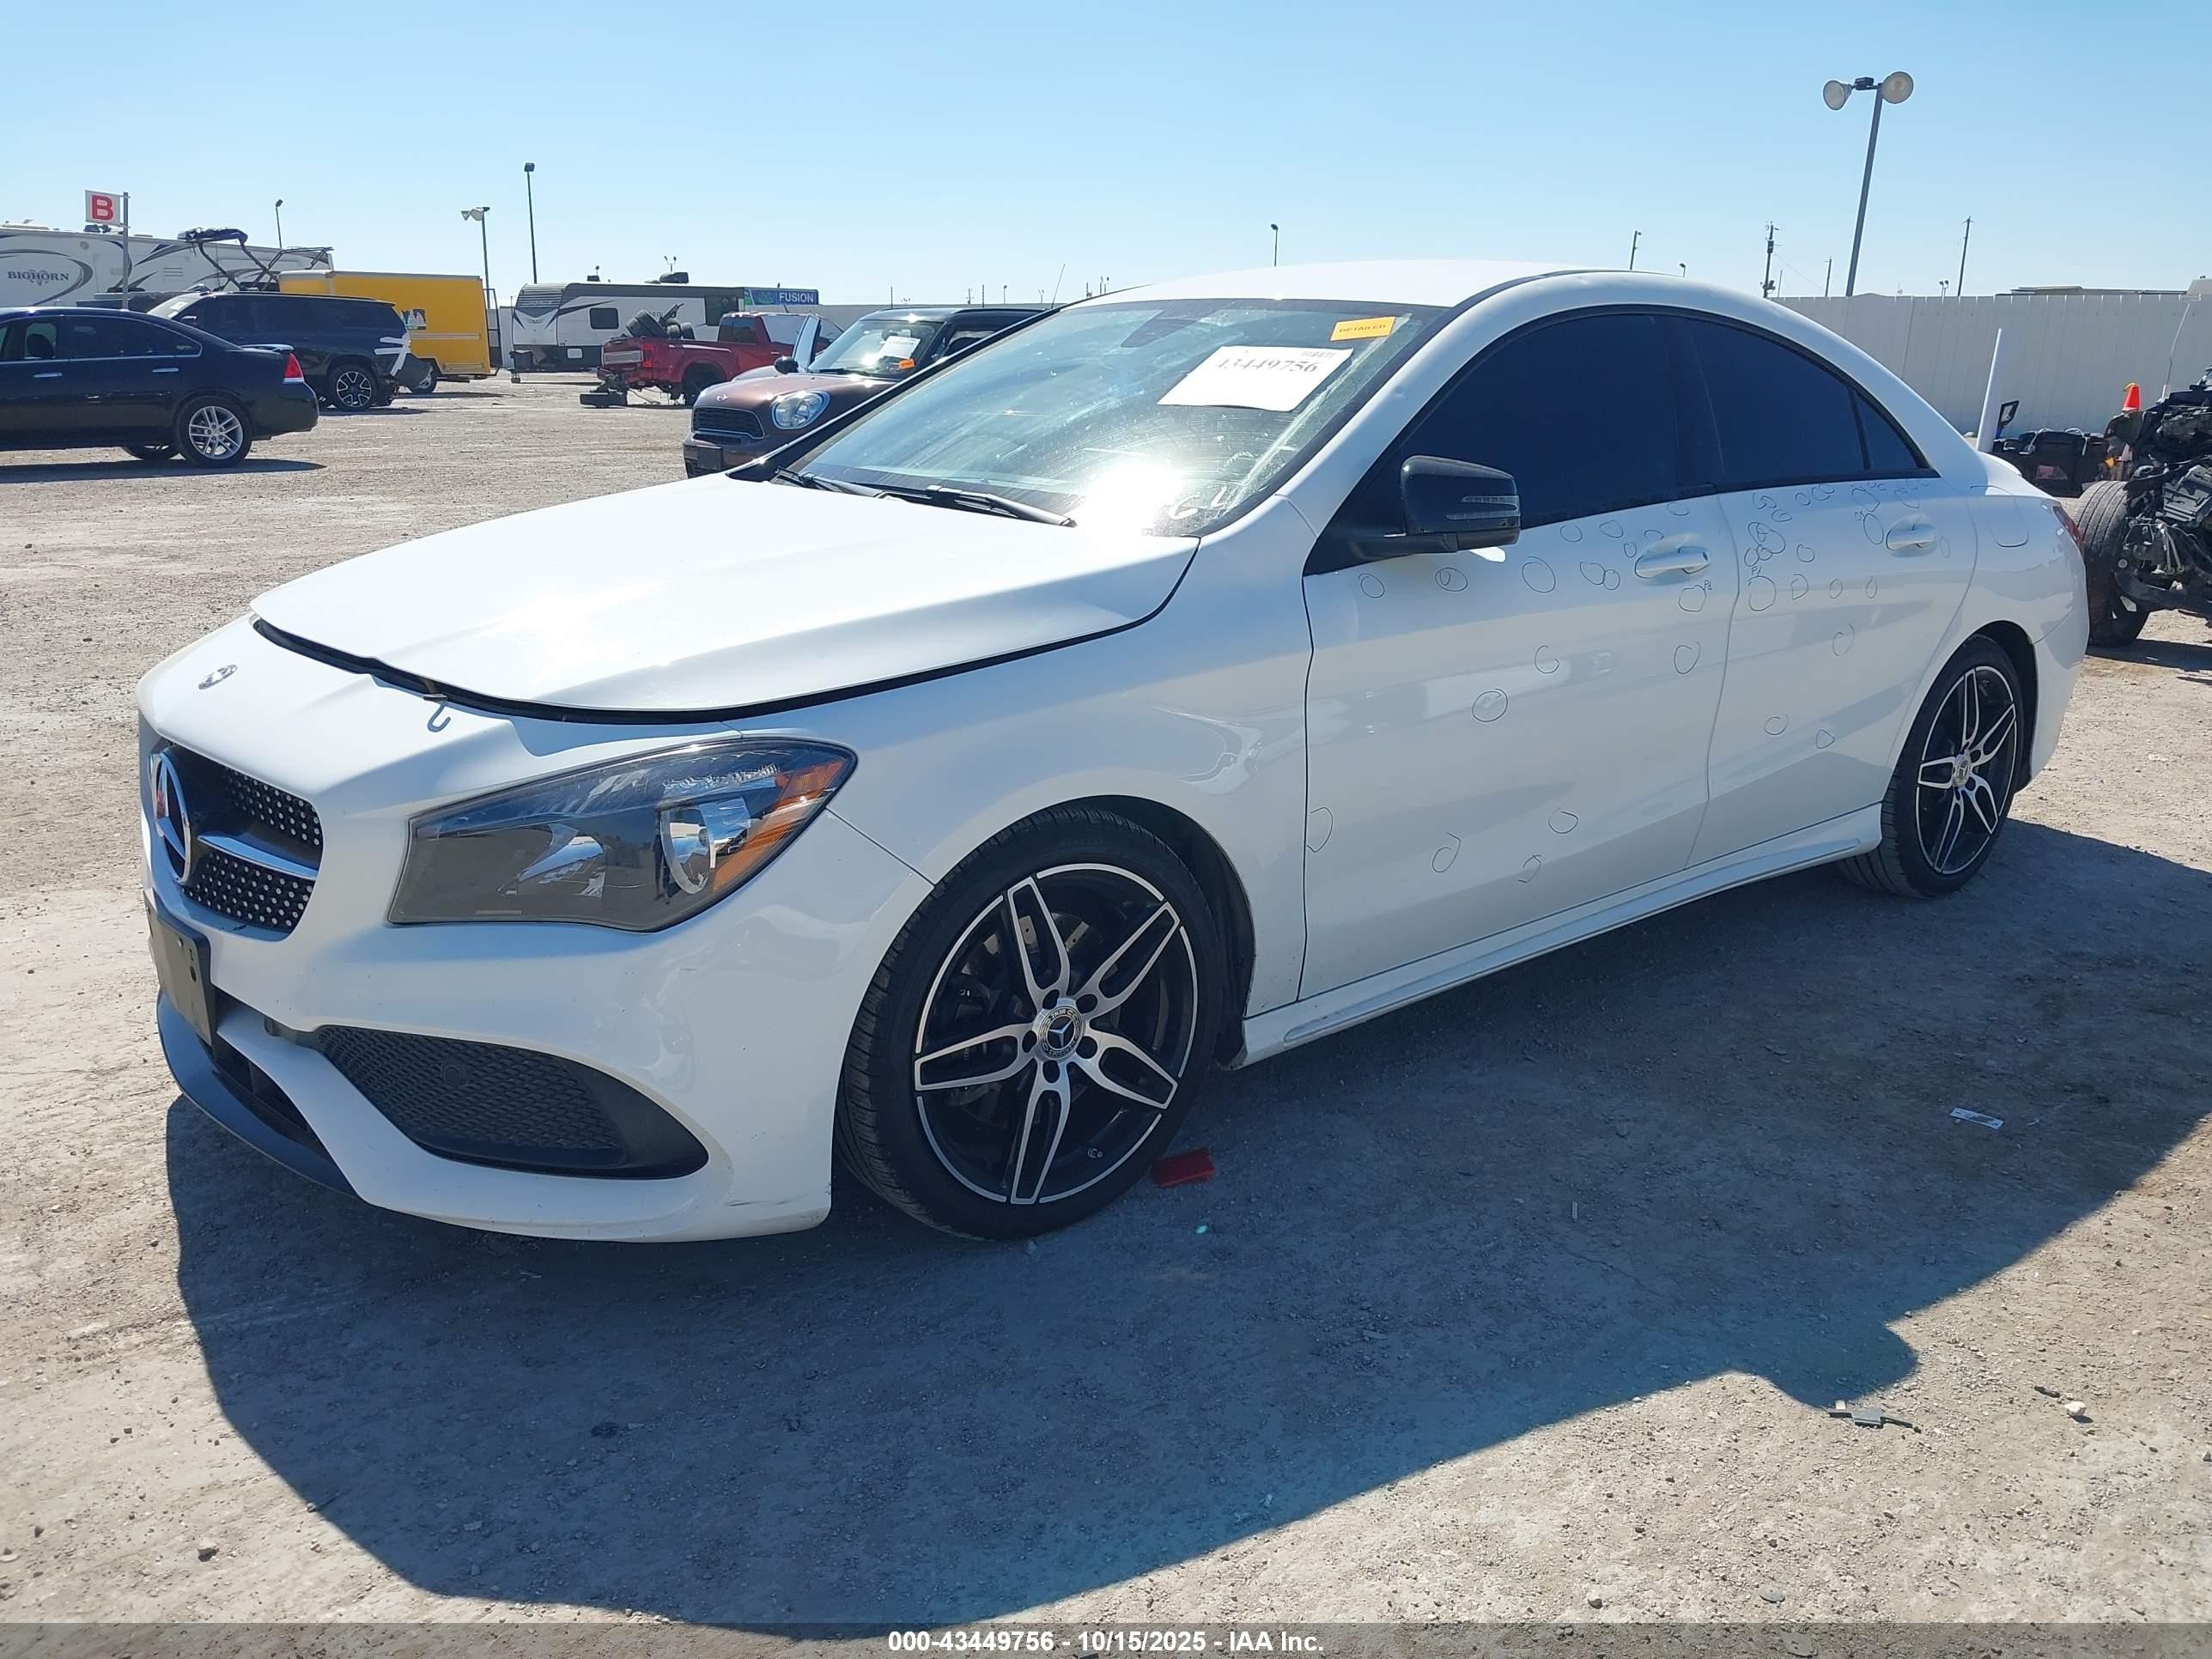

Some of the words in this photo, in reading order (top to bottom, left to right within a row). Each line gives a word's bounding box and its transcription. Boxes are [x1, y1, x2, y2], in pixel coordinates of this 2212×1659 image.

[91, 194, 114, 221] B
[7, 270, 70, 283] BIGHORN
[779, 292, 814, 303] FUSION
[1215, 358, 1321, 373] 43449756
